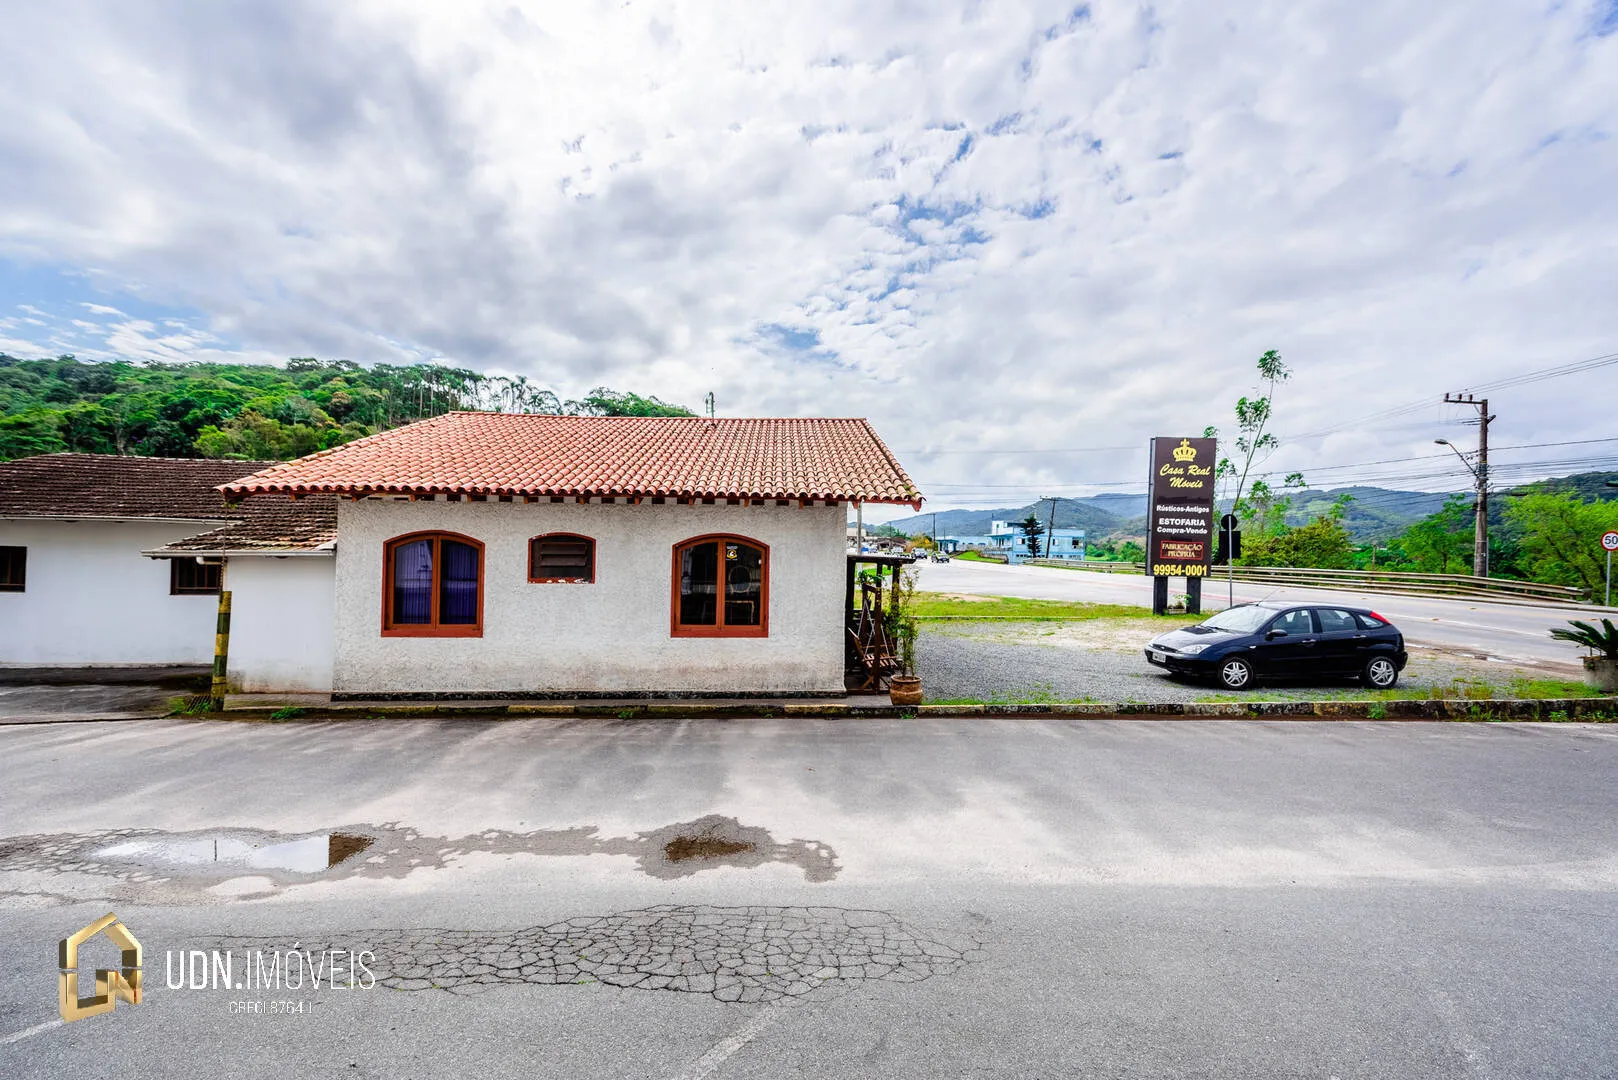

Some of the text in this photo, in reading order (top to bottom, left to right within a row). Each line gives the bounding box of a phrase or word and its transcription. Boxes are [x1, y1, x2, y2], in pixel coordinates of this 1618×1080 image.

[1160, 463, 1211, 476] Casa Real
[1158, 517, 1206, 526] ESTOFARIA
[1604, 535, 1618, 545] 50
[1153, 564, 1208, 576] 99954-0001
